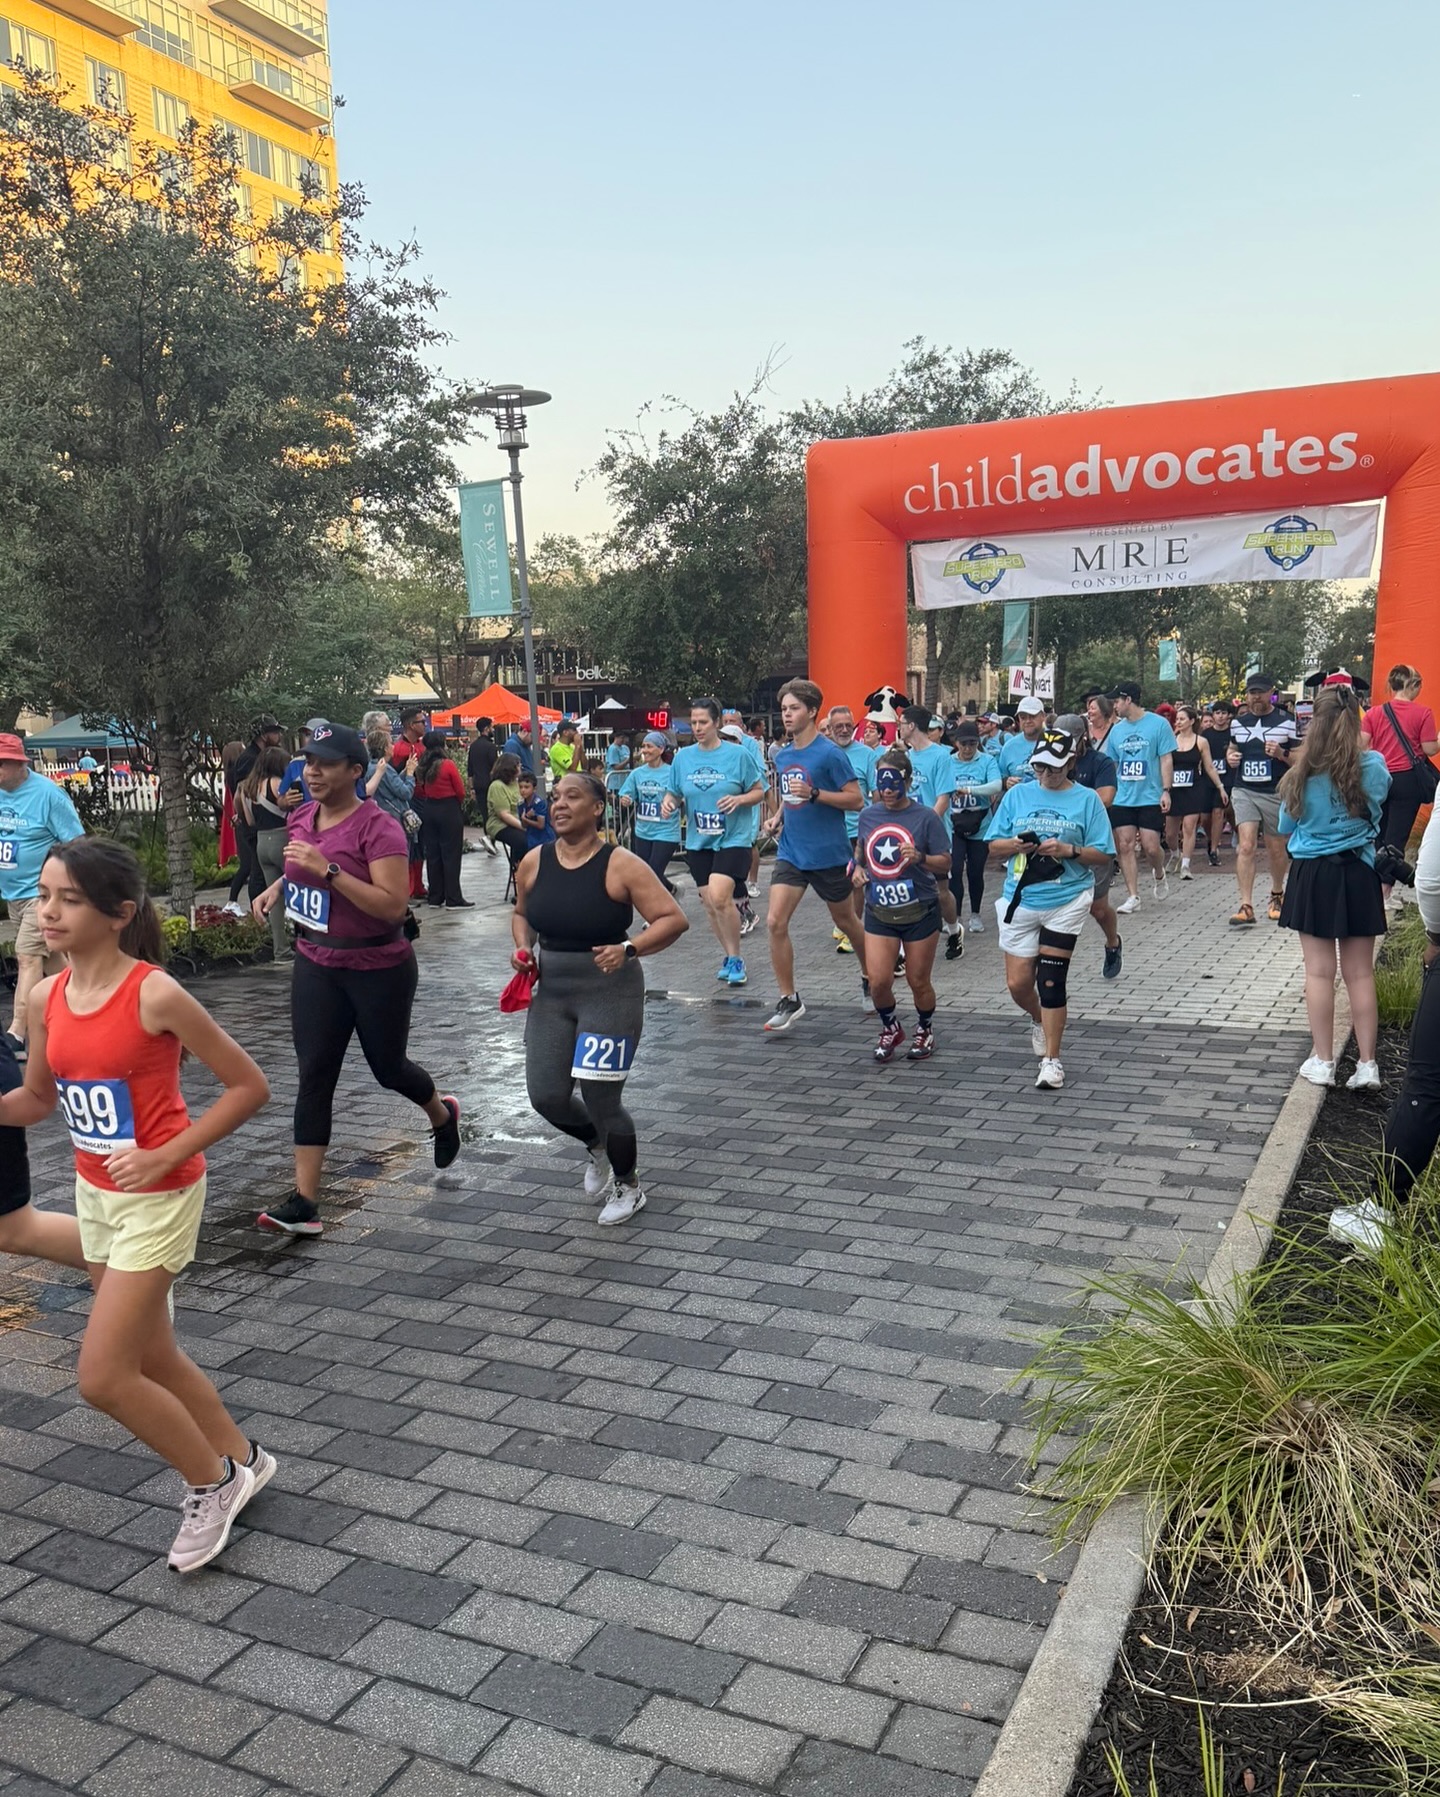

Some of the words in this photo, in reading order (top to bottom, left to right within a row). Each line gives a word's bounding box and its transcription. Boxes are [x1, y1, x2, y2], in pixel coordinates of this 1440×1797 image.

[1089, 525, 1154, 537] PRESENTED
[1160, 523, 1175, 531] BY
[1248, 533, 1333, 546] SUPERHERO
[483, 503, 500, 600] SEWELL
[1275, 543, 1304, 555] RUN
[946, 556, 1022, 574] SUPERHERO
[971, 569, 999, 581] RUN
[1071, 571, 1188, 589] CONSULTING
[1024, 675, 1051, 692] stwart
[647, 711, 668, 728] 48
[1123, 761, 1143, 776] 549
[1244, 761, 1267, 776] 655
[1173, 770, 1191, 783] 697
[641, 802, 657, 816] 175
[696, 813, 720, 829] 613
[1015, 817, 1077, 829] SUPERHERO
[287, 882, 323, 920] 219
[876, 882, 911, 906] 339
[581, 1036, 626, 1069] 221
